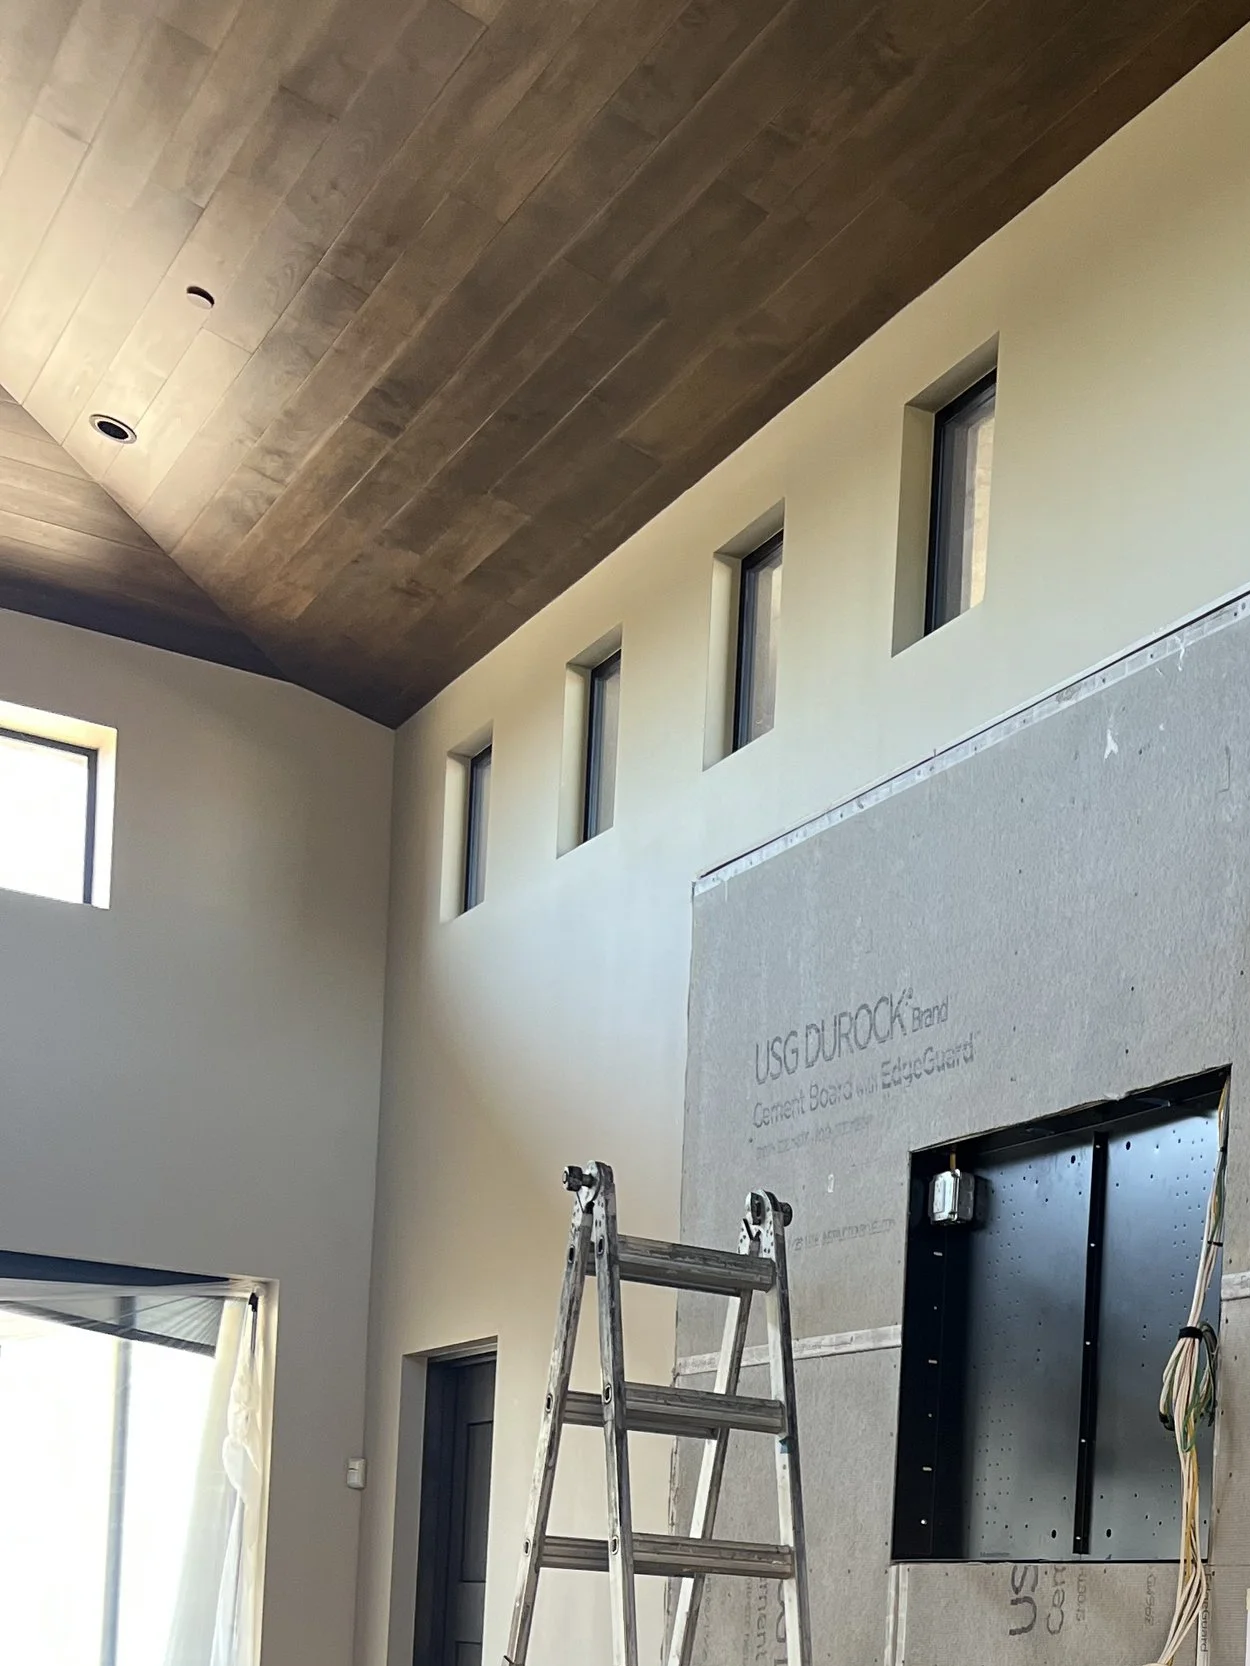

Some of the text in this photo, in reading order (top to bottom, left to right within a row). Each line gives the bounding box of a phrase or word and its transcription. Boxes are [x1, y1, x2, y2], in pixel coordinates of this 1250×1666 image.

[752, 1087, 806, 1129] Cement
[809, 1073, 853, 1112] Board
[880, 1032, 975, 1092] EdgeGuard
[755, 1030, 799, 1085] USG
[912, 997, 949, 1032] Brand
